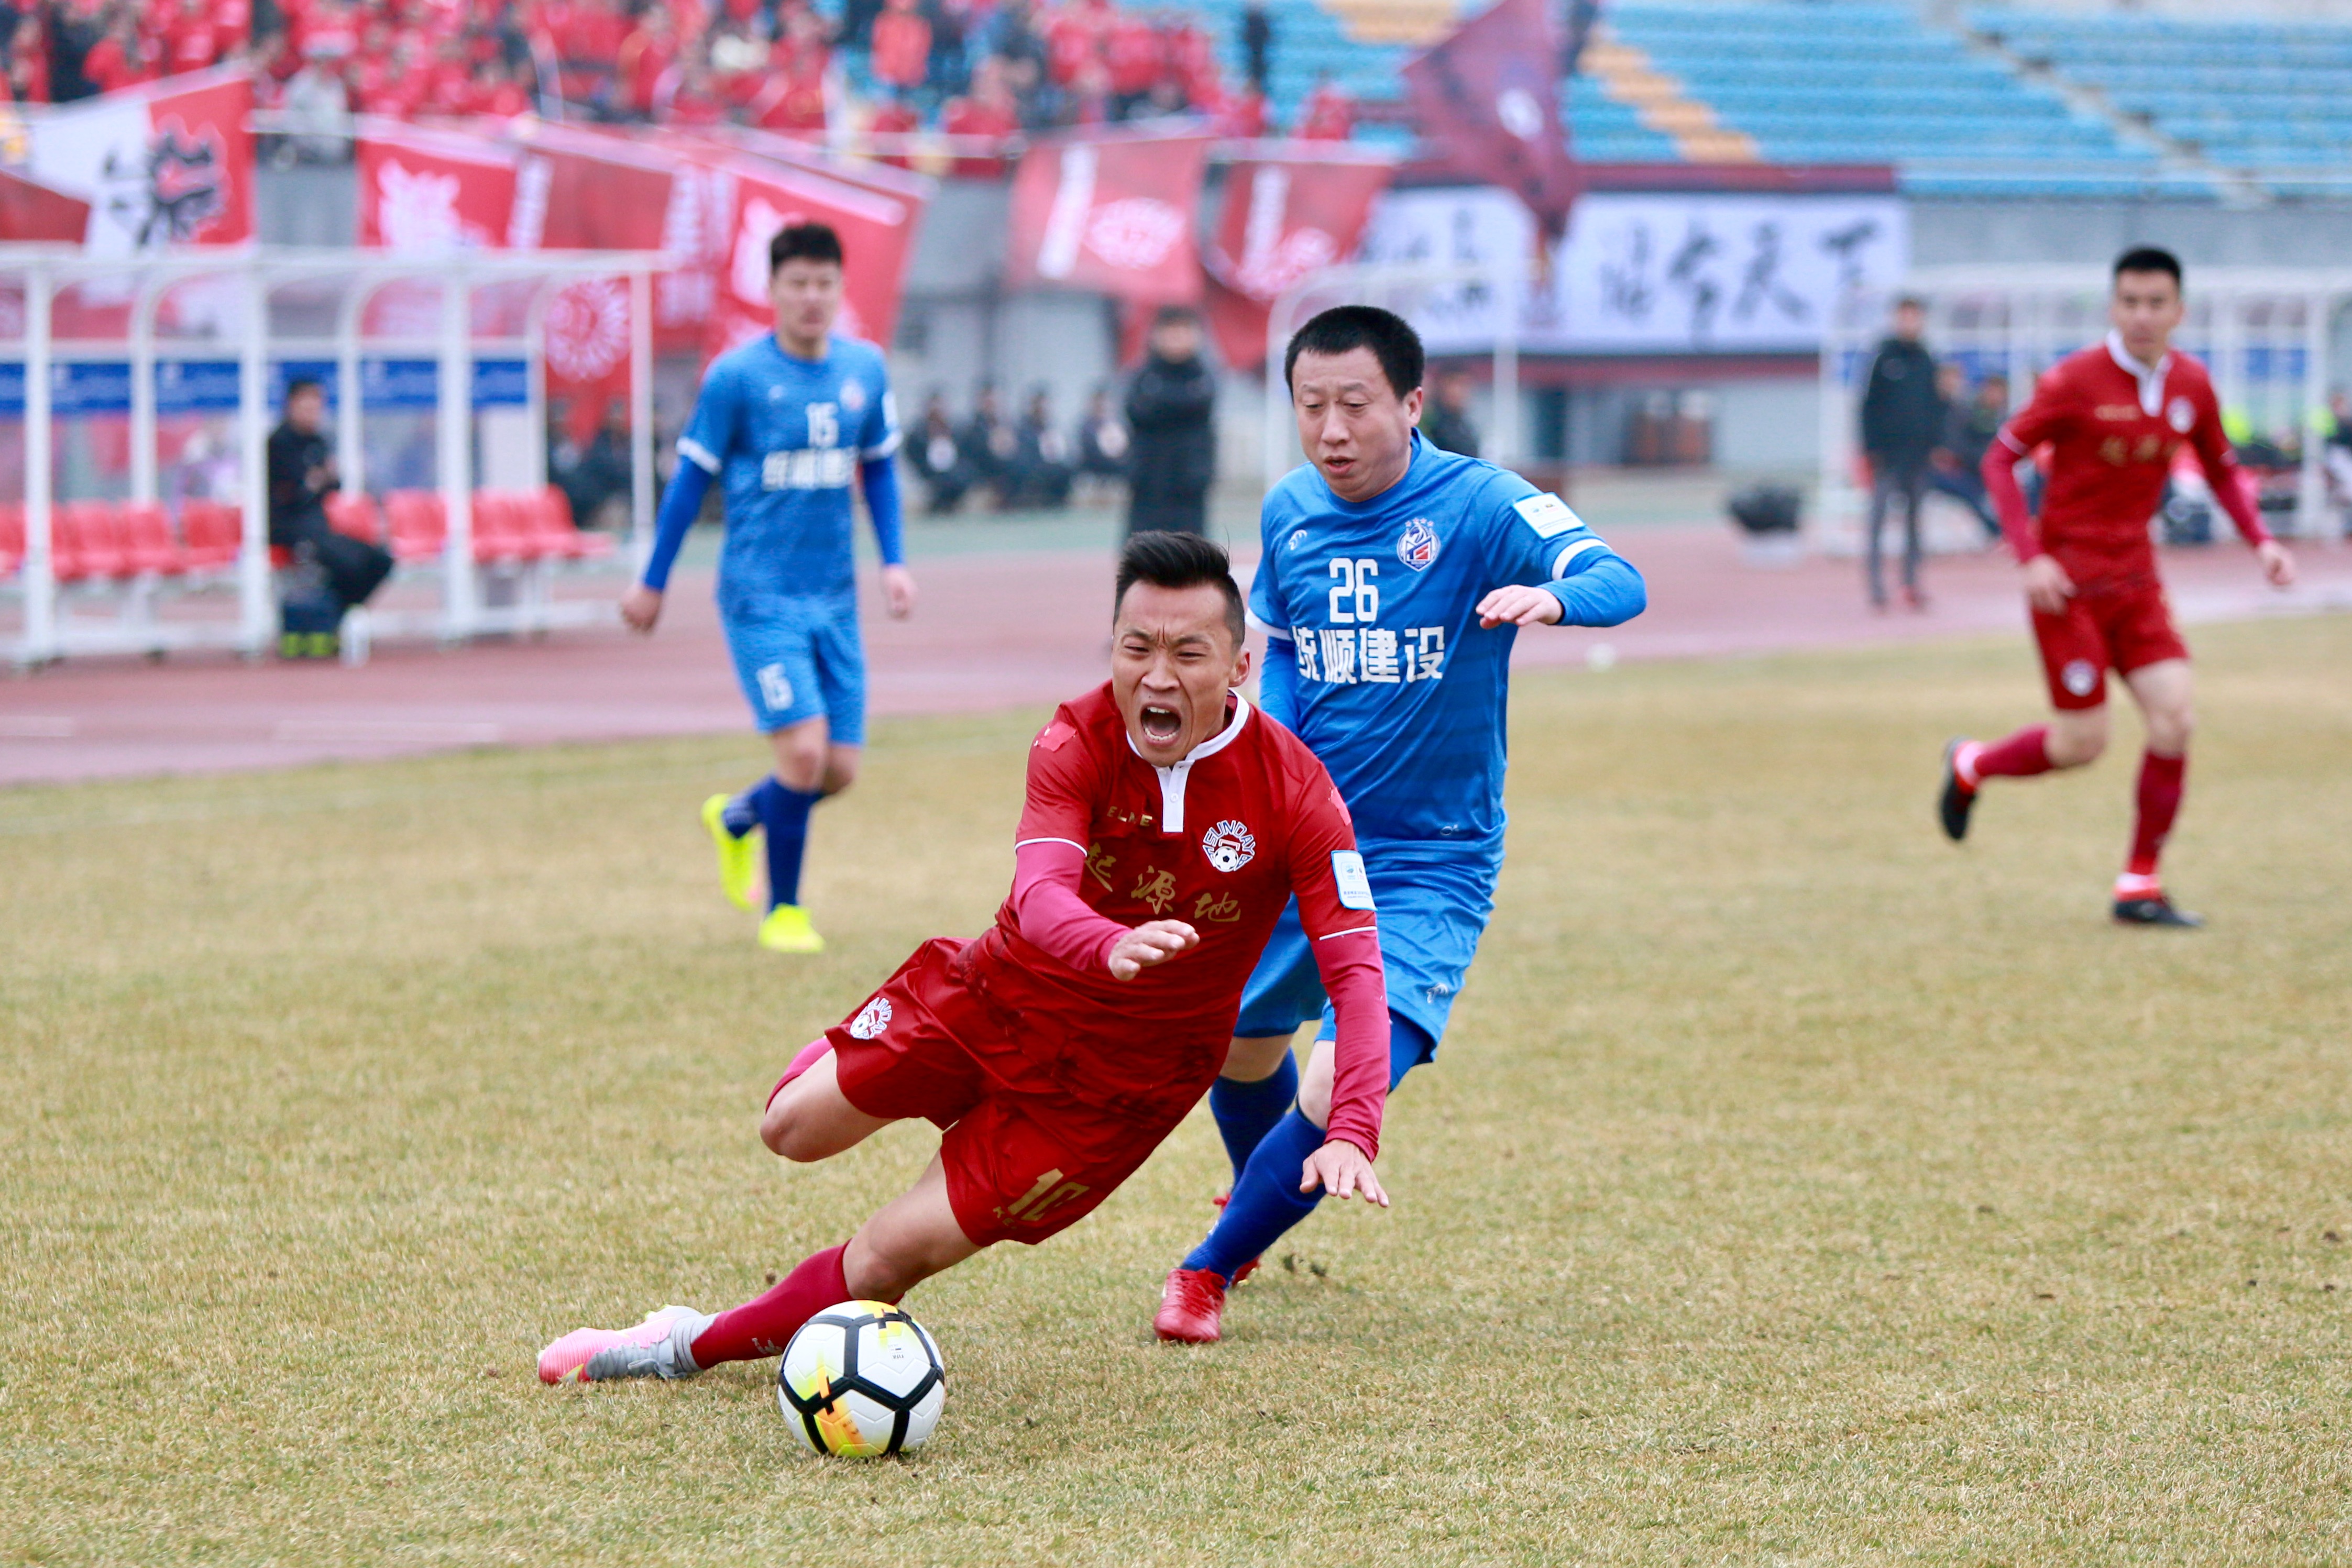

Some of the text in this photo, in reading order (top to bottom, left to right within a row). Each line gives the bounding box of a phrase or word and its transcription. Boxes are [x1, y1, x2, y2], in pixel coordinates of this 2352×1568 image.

[806, 402, 839, 447] 15
[1328, 557, 1379, 623] 26
[1292, 626, 1445, 684] 统顺建设
[1203, 820, 1256, 856] SUNDAY
